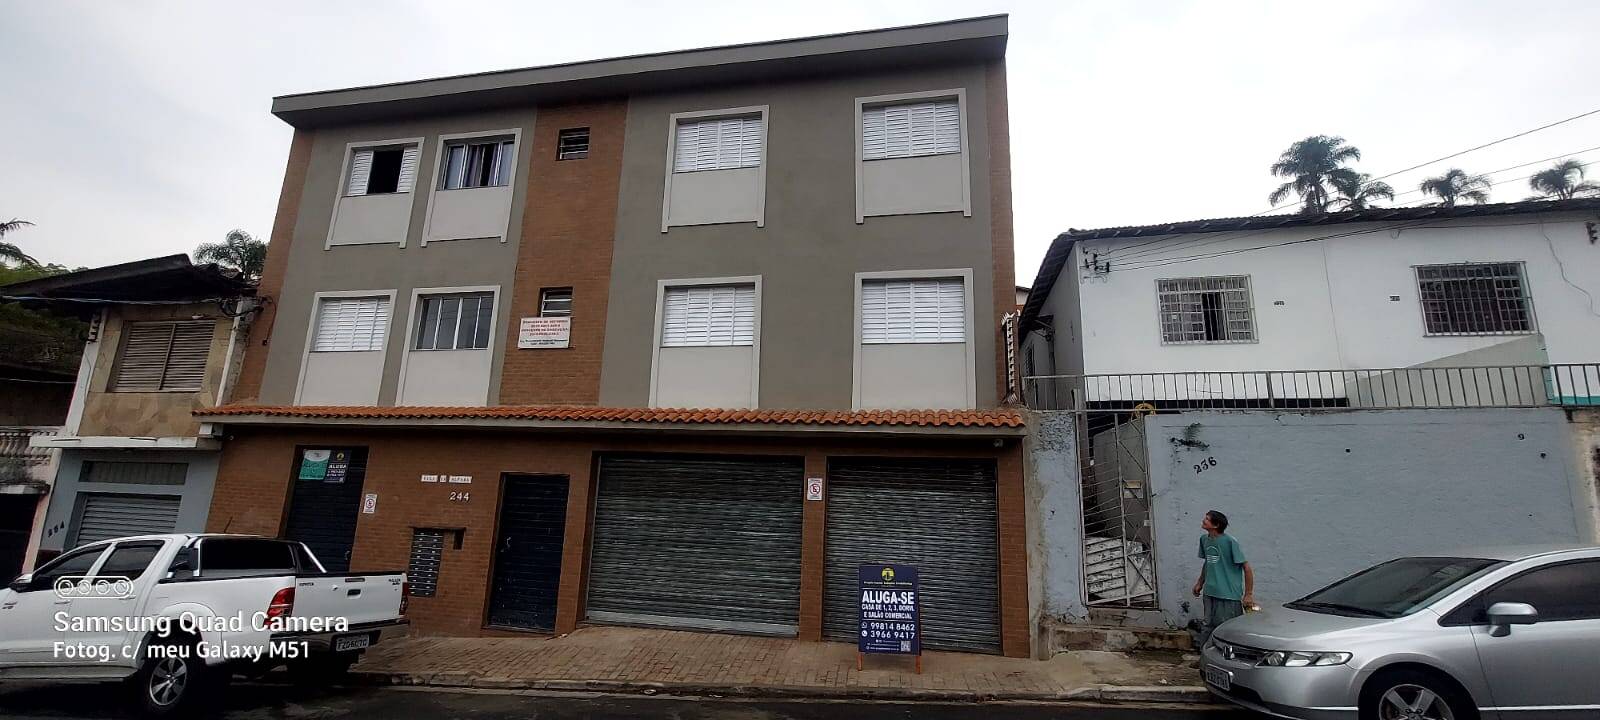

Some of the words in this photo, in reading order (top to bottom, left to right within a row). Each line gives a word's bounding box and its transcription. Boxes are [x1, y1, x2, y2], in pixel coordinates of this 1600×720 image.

[1193, 456, 1217, 474] 236
[449, 491, 470, 501] 244
[862, 590, 914, 604] ALUGA-SE
[868, 610, 884, 619] SALÃO
[870, 622, 894, 630] 99814
[896, 623, 915, 631] 8462
[870, 630, 891, 638] 3966
[894, 631, 915, 639] 9417
